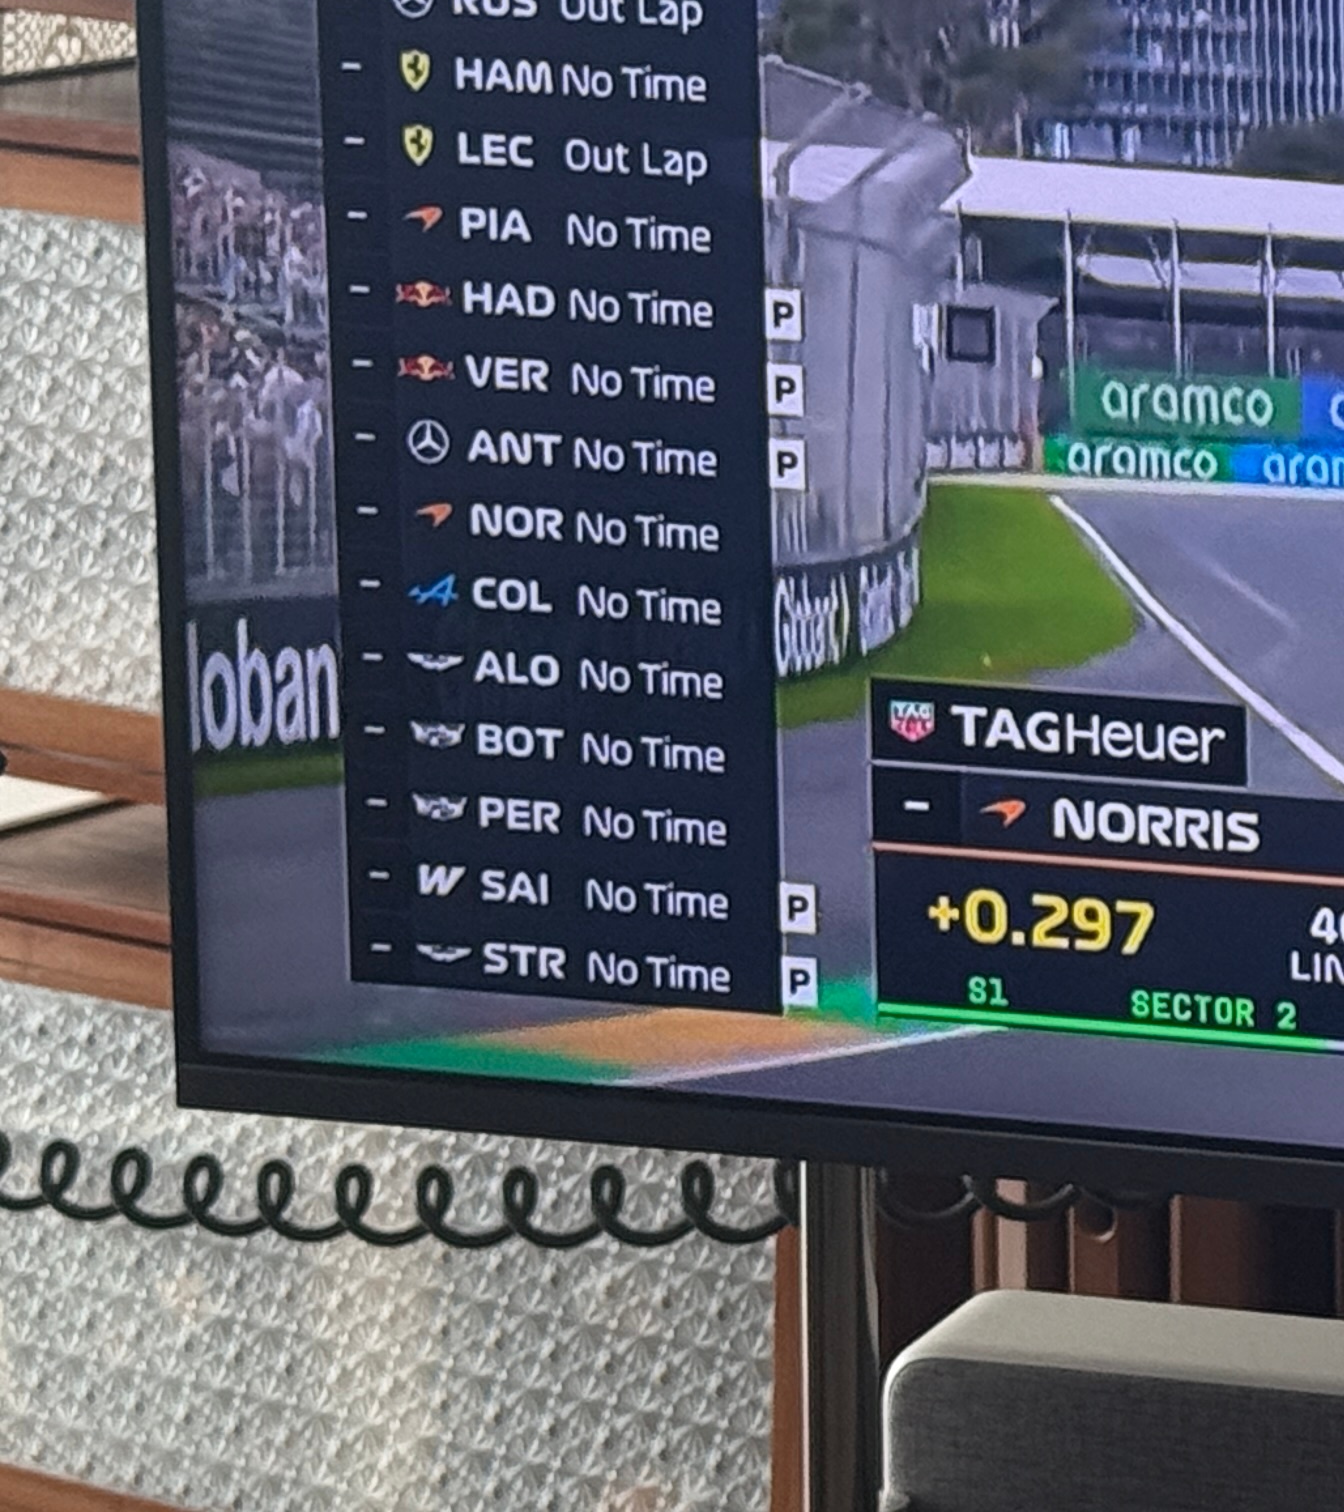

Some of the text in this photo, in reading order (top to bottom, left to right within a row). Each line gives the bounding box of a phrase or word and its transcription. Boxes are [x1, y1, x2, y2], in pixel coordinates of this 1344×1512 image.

[455, 57, 707, 102] HAM No Time
[458, 132, 707, 184] LEC Out Lap
[460, 207, 711, 253] PIA No Time
[463, 282, 794, 328] HAD No Time P
[465, 355, 796, 404] VER No Time P
[1101, 378, 1273, 428] aramco
[468, 430, 798, 478] ANT No Time P
[1067, 441, 1217, 482] aramco
[470, 504, 720, 552] NOR No Time
[473, 577, 722, 626] COL No Time
[475, 650, 723, 699] ALO No Time
[477, 723, 725, 773] BOT No Time
[480, 797, 727, 847] PER No Time
[1052, 797, 1260, 852] NORRIS
[481, 870, 549, 905] SAI
[586, 879, 636, 914] No
[644, 882, 728, 920] Time
[788, 899, 809, 924] P
[928, 888, 1155, 956] +0.297
[484, 942, 811, 997] STR No Time P
[967, 976, 1008, 1007] S1
[1131, 990, 1255, 1028] SECTOR
[1276, 1001, 1297, 1031] 2
